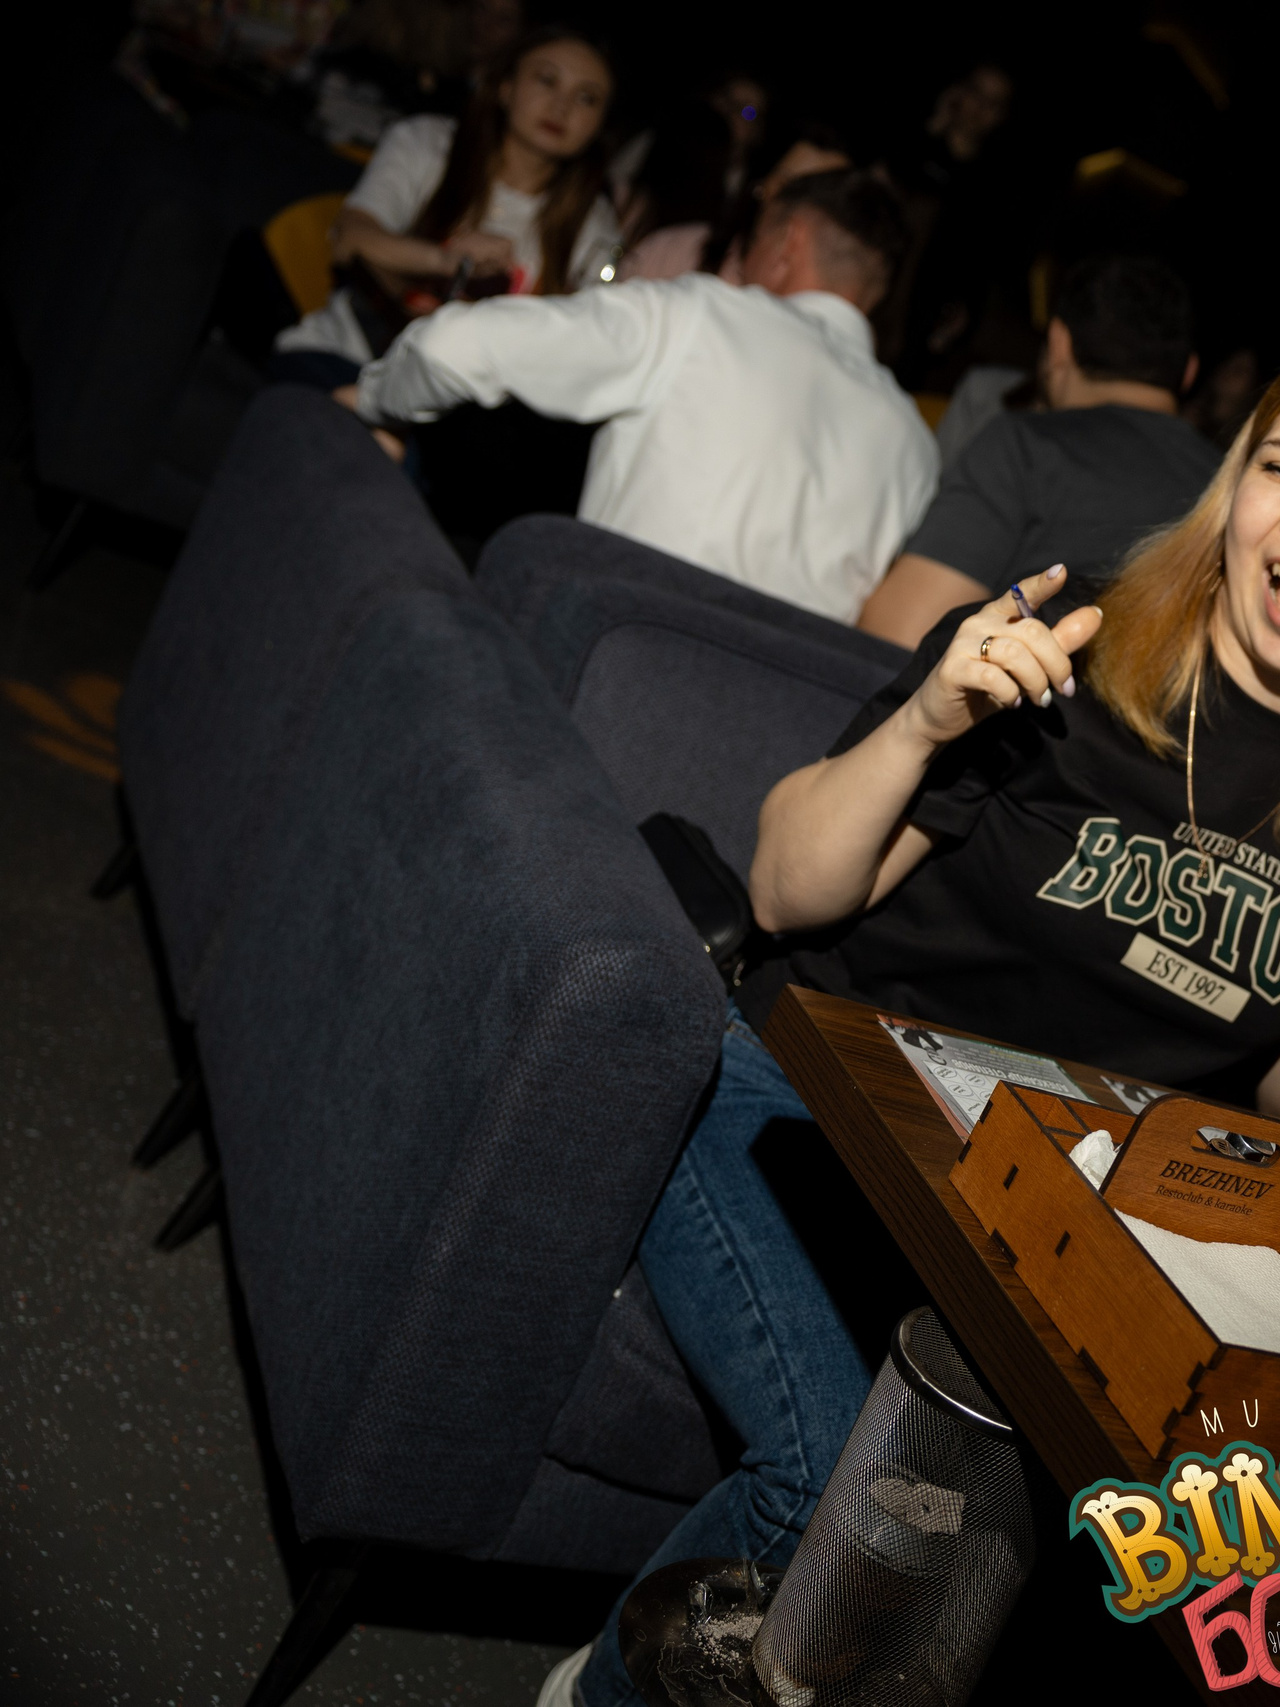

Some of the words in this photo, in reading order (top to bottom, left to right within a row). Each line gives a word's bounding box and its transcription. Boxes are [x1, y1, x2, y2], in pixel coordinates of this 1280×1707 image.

[1173, 822, 1237, 858] UNITED
[1146, 950, 1188, 985] EST
[1183, 971, 1226, 1006] 1997
[1159, 1160, 1275, 1200] BREZHNEV
[1156, 1185, 1203, 1205] Restoclub
[1204, 1195, 1213, 1207] &
[1214, 1198, 1253, 1216] karaoke
